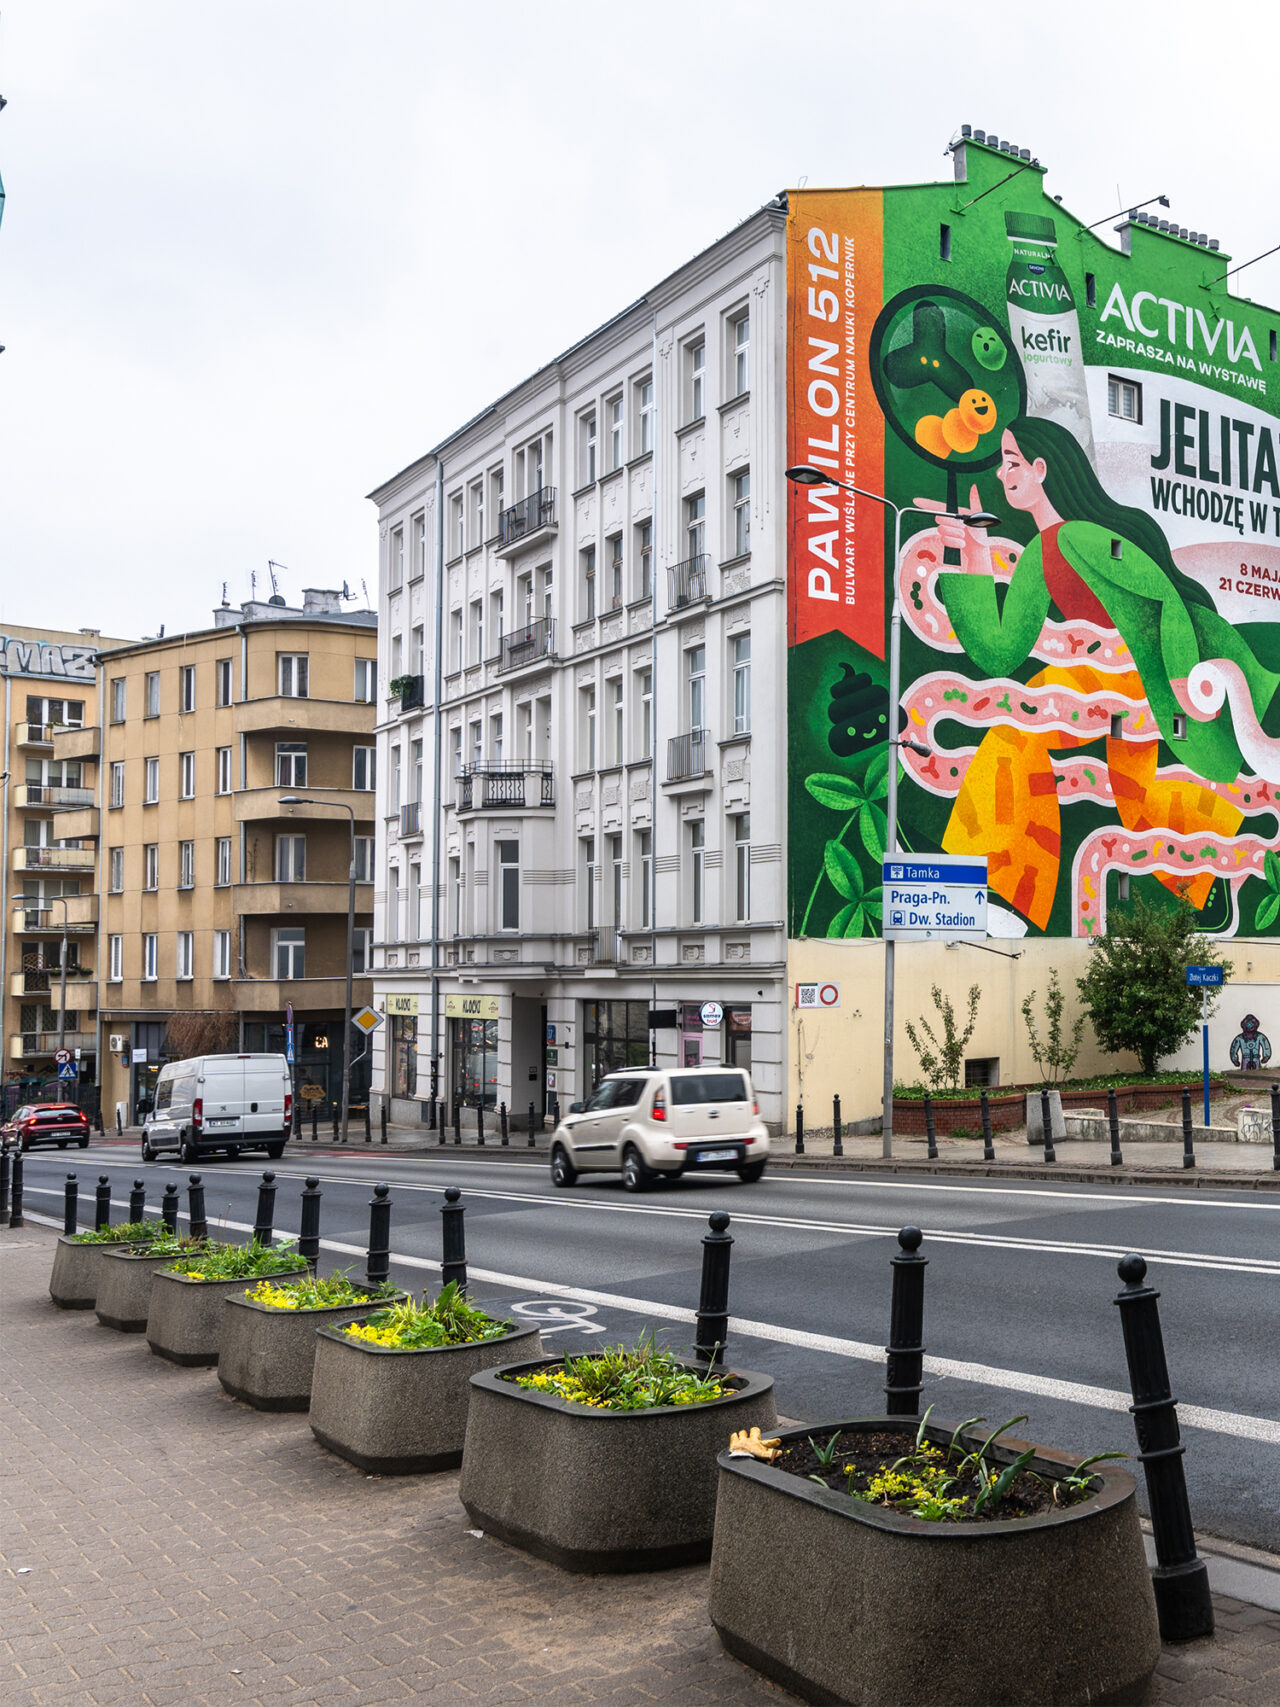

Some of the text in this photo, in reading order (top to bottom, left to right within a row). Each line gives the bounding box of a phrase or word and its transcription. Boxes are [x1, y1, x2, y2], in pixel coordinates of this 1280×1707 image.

[1009, 278, 1071, 301] ACTIVIA
[1100, 282, 1262, 371] ACTIVIA
[1021, 326, 1071, 353] kefir
[1023, 352, 1072, 366] jogurtowy
[1096, 330, 1266, 395] ZAPRASZA NA WYSTAWĘ
[808, 227, 840, 602] PAWILON 512
[843, 237, 856, 605] BULWARY WIŚLANE PRZY CENTRUM NAUKI KOPERNIK
[1151, 477, 1244, 535] WCHODZĘ
[1250, 501, 1268, 534] W
[1240, 563, 1248, 576] 8
[1219, 577, 1232, 591] 21
[906, 867, 940, 878] Tamka
[891, 890, 951, 907] Praga-Pn.
[909, 912, 975, 926] Dw. Stadion
[395, 998, 411, 1011] KLOCKI
[462, 1000, 481, 1013] KLOCKI
